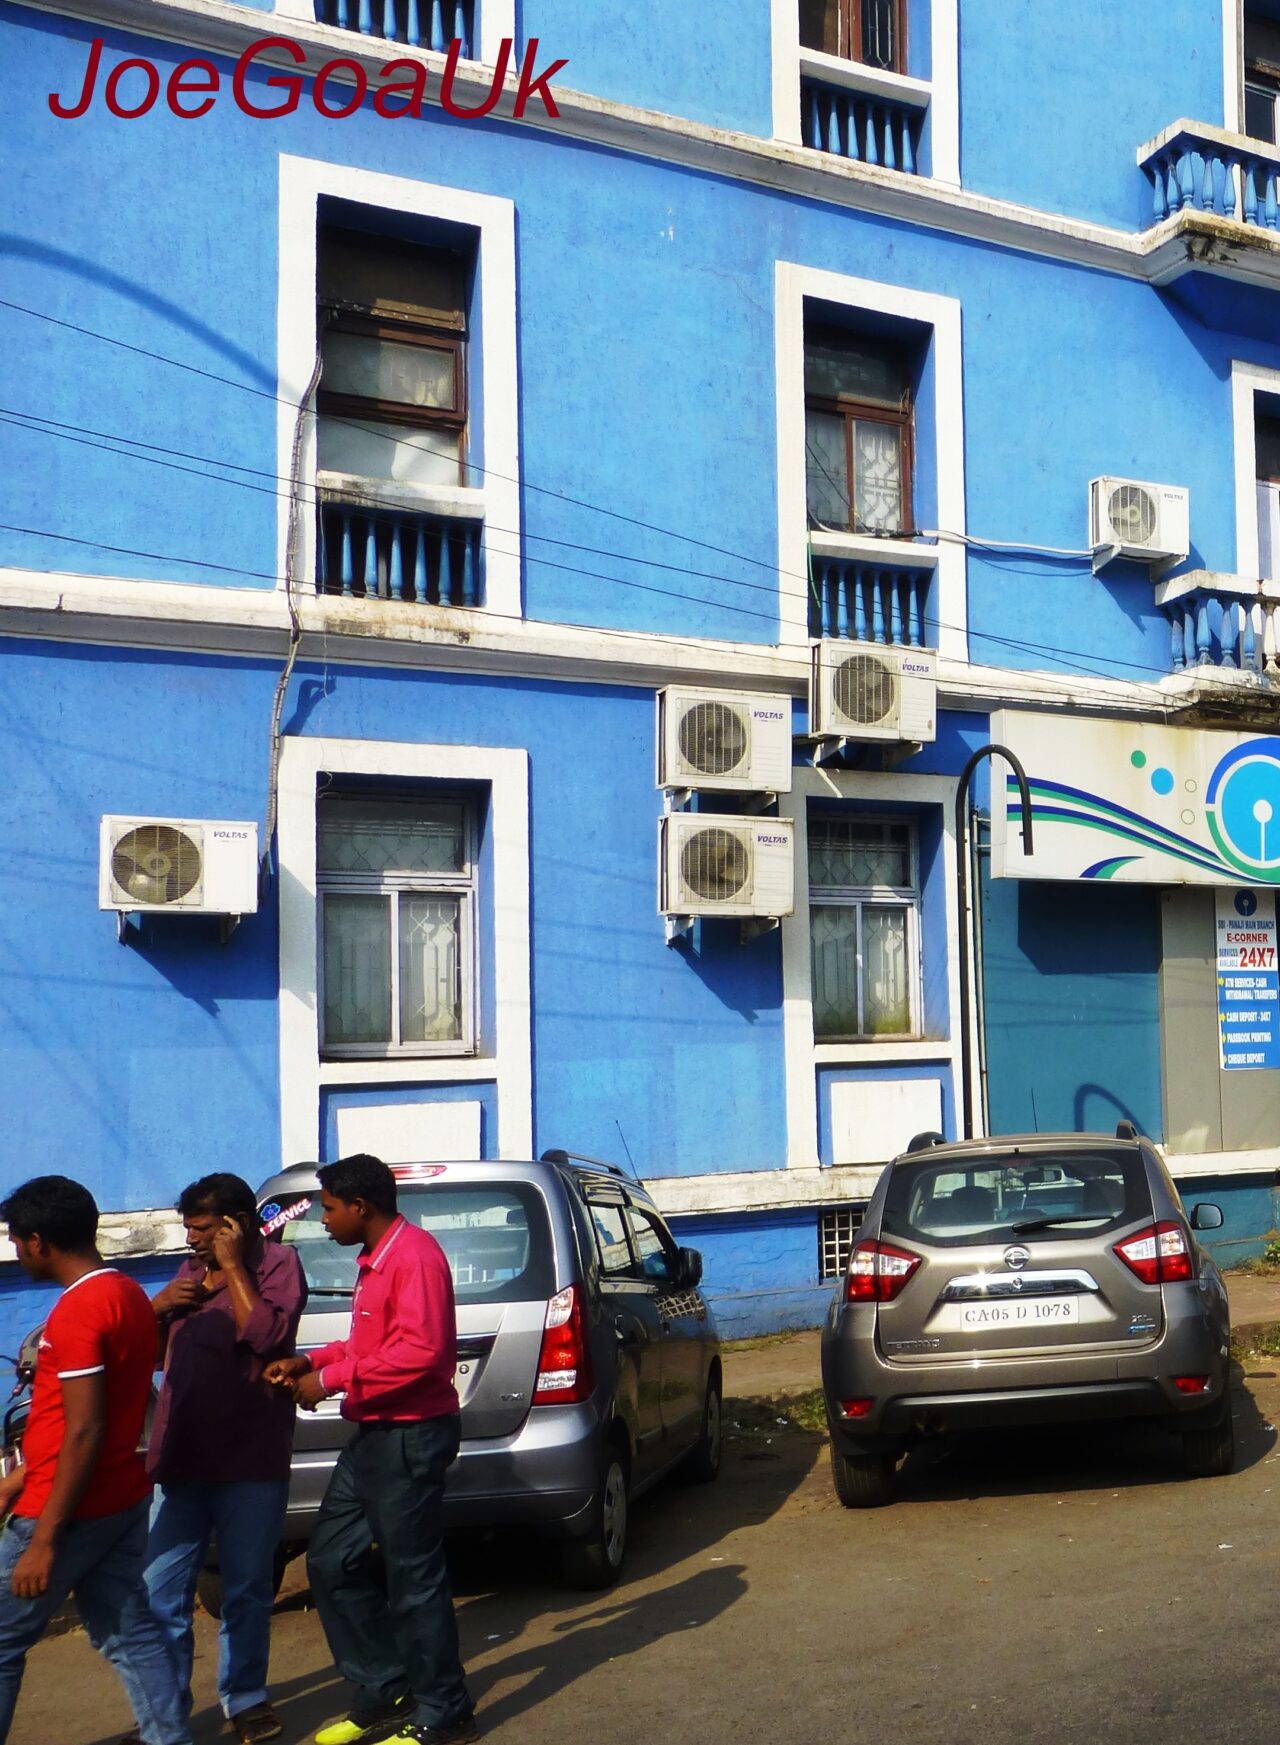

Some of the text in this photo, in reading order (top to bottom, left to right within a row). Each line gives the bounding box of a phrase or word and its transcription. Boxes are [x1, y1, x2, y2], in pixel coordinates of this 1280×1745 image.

[902, 663, 929, 673] VOLTAS
[753, 711, 784, 720] VOLTAS
[213, 831, 248, 839] VOLTAS
[757, 835, 788, 844] VOLTAS
[1227, 932, 1268, 942] E-CORNER
[1240, 947, 1275, 968] 24X7
[268, 1198, 312, 1232] SERVICE
[1016, 1306, 1027, 1319] D
